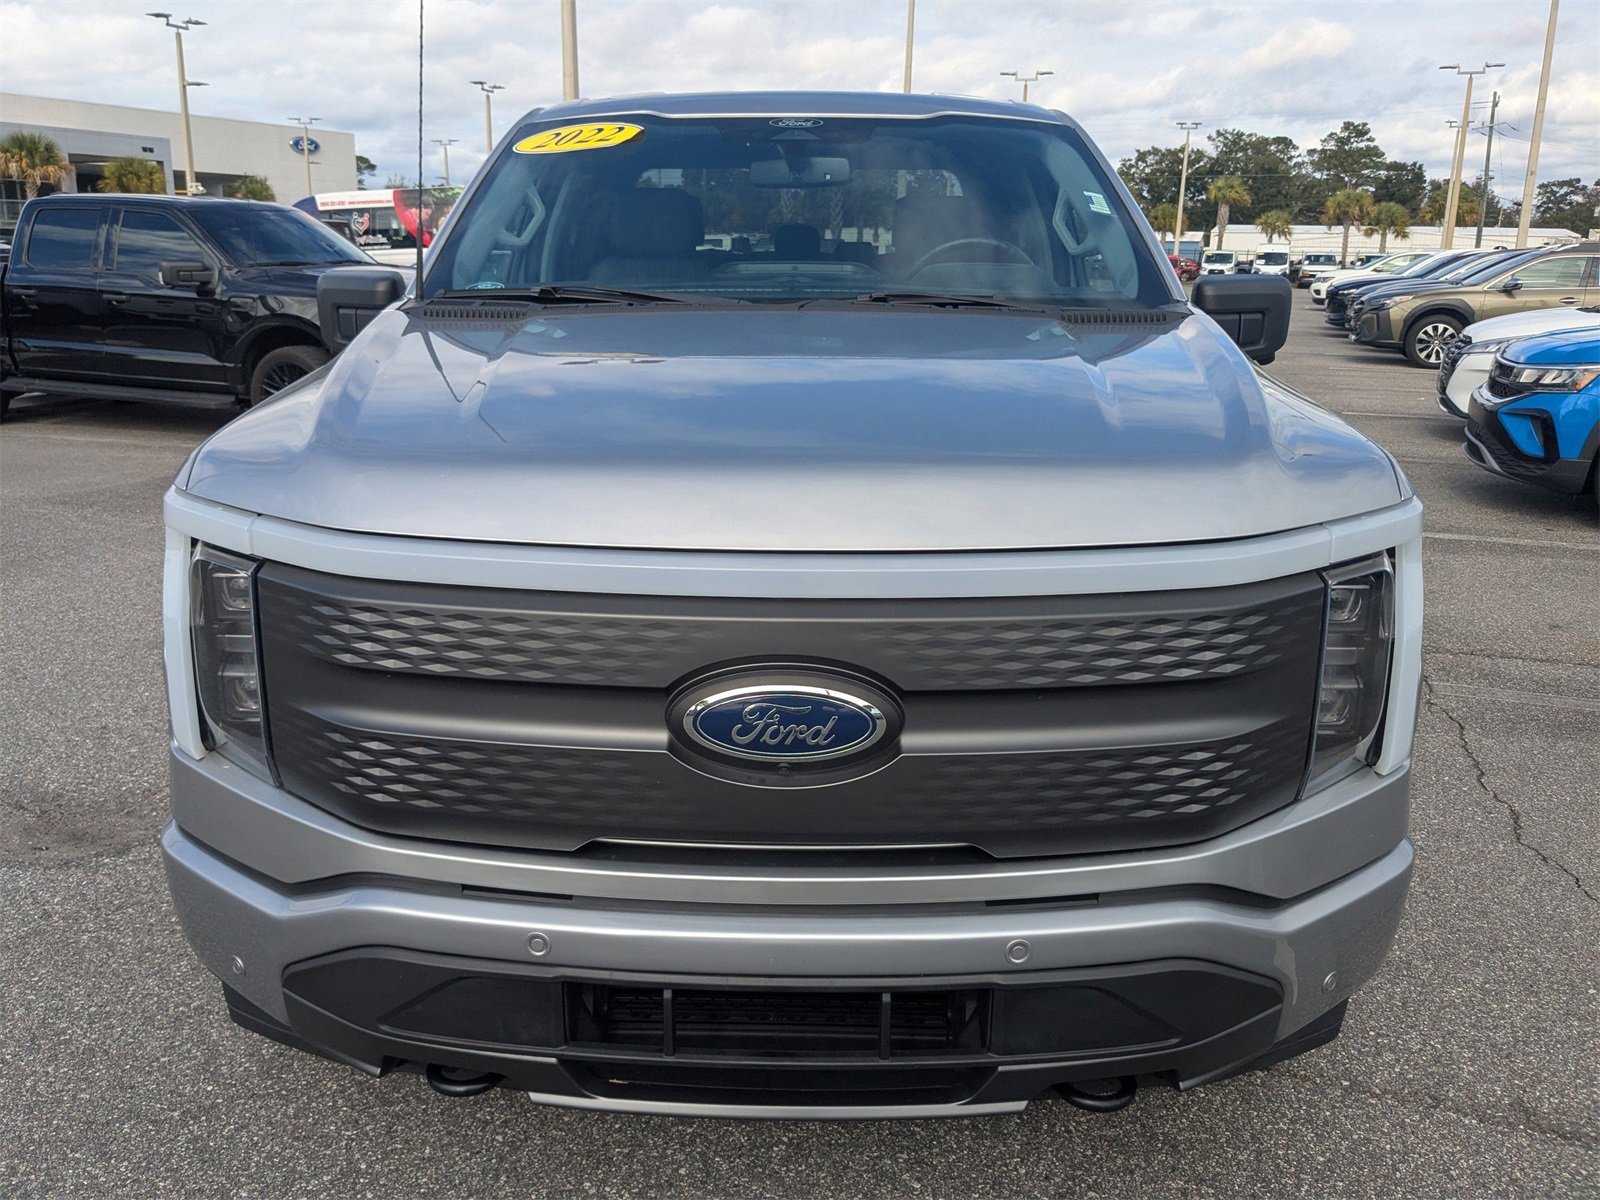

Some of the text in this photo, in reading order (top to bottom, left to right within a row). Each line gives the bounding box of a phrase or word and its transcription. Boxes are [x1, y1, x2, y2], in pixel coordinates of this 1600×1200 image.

[779, 119, 814, 127] Ford
[530, 127, 625, 150] 2022
[731, 702, 838, 745] Ford
